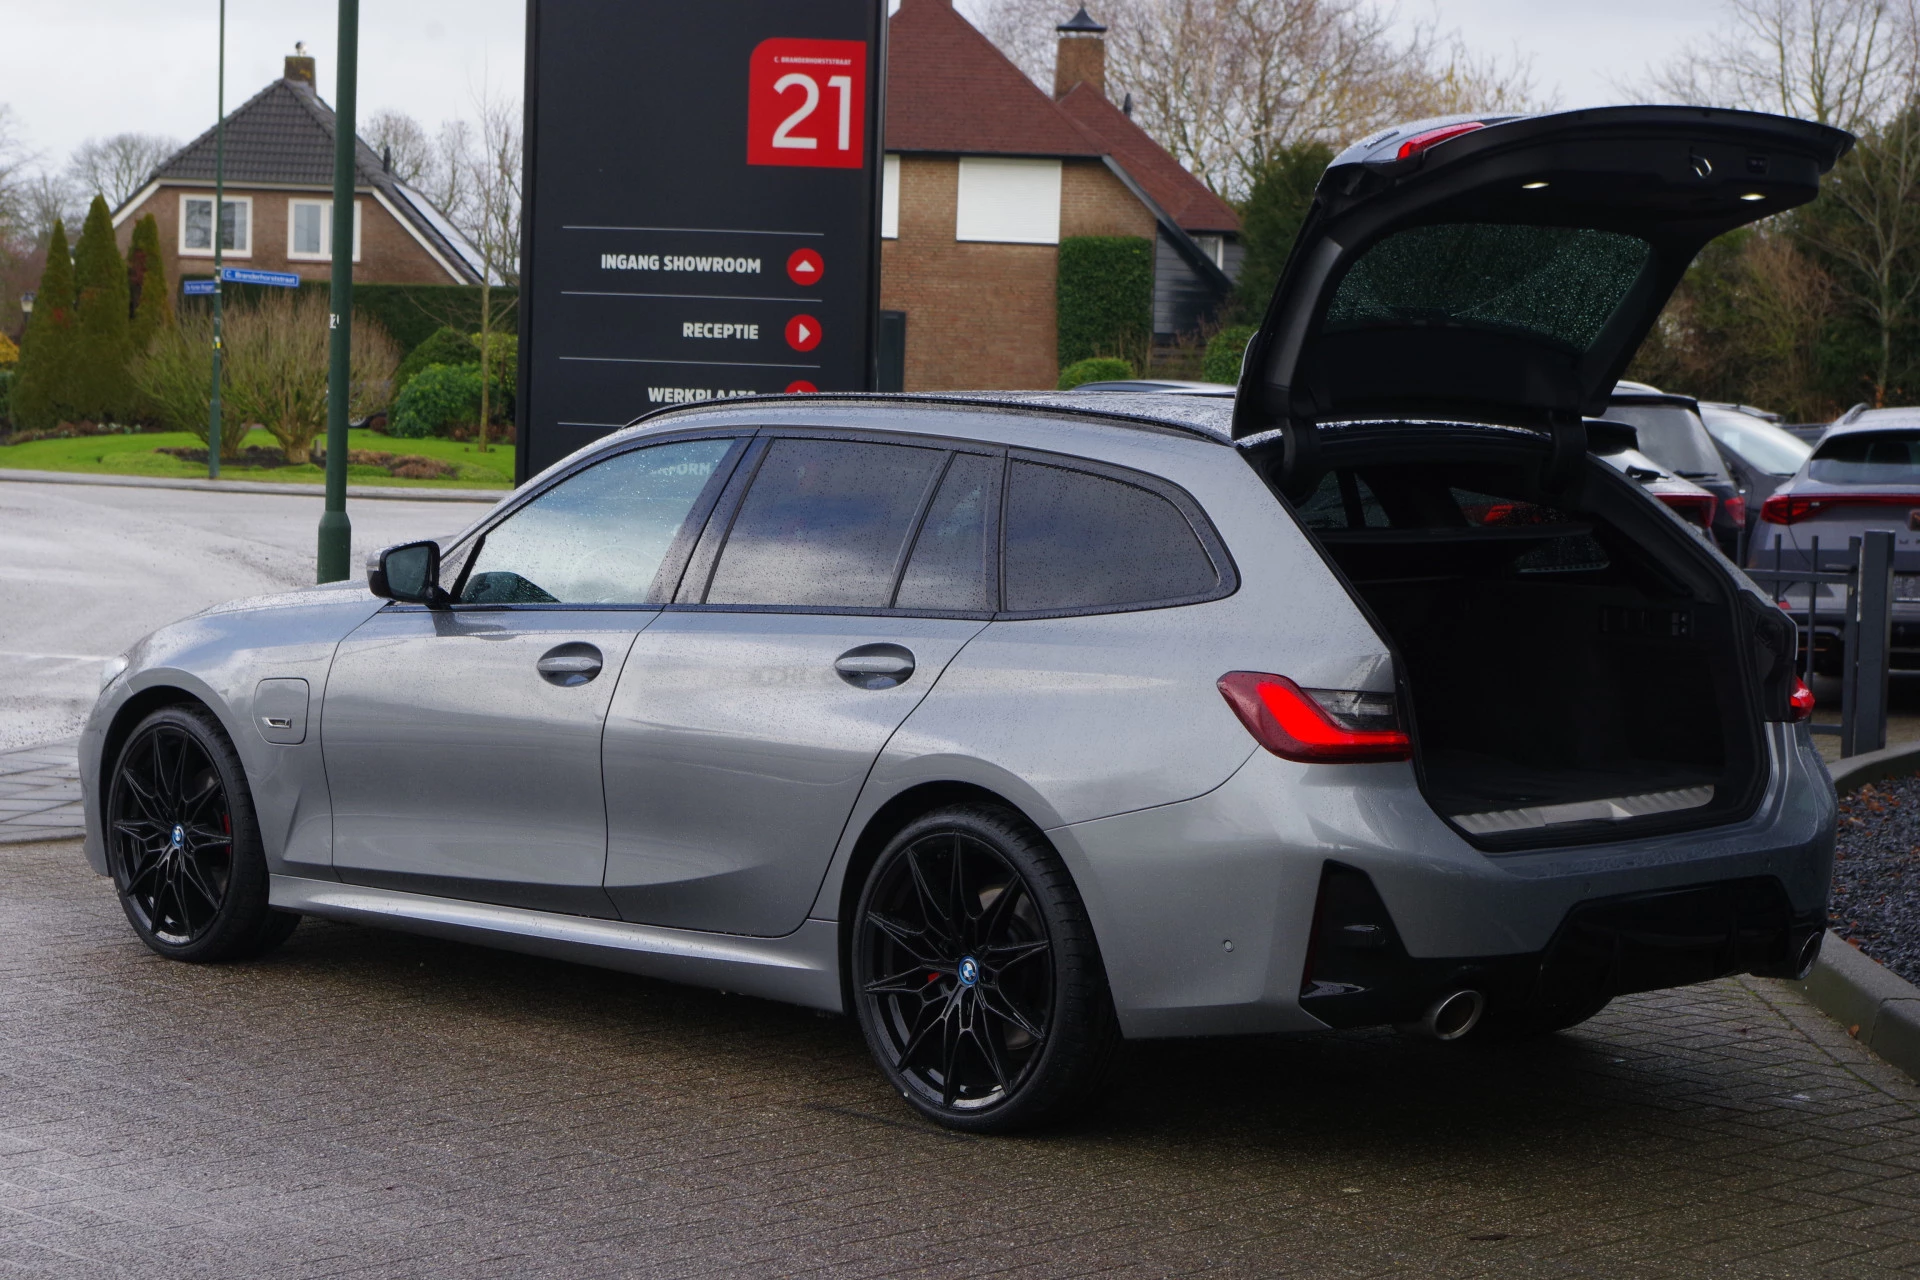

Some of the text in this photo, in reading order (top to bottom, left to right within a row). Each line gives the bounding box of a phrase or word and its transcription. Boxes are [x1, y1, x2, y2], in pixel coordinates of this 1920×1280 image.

[772, 72, 852, 151] 21
[601, 253, 761, 274] INGANG SHOWROOM
[682, 322, 759, 340] RECEPTIE
[647, 387, 757, 404] WERKPLA
